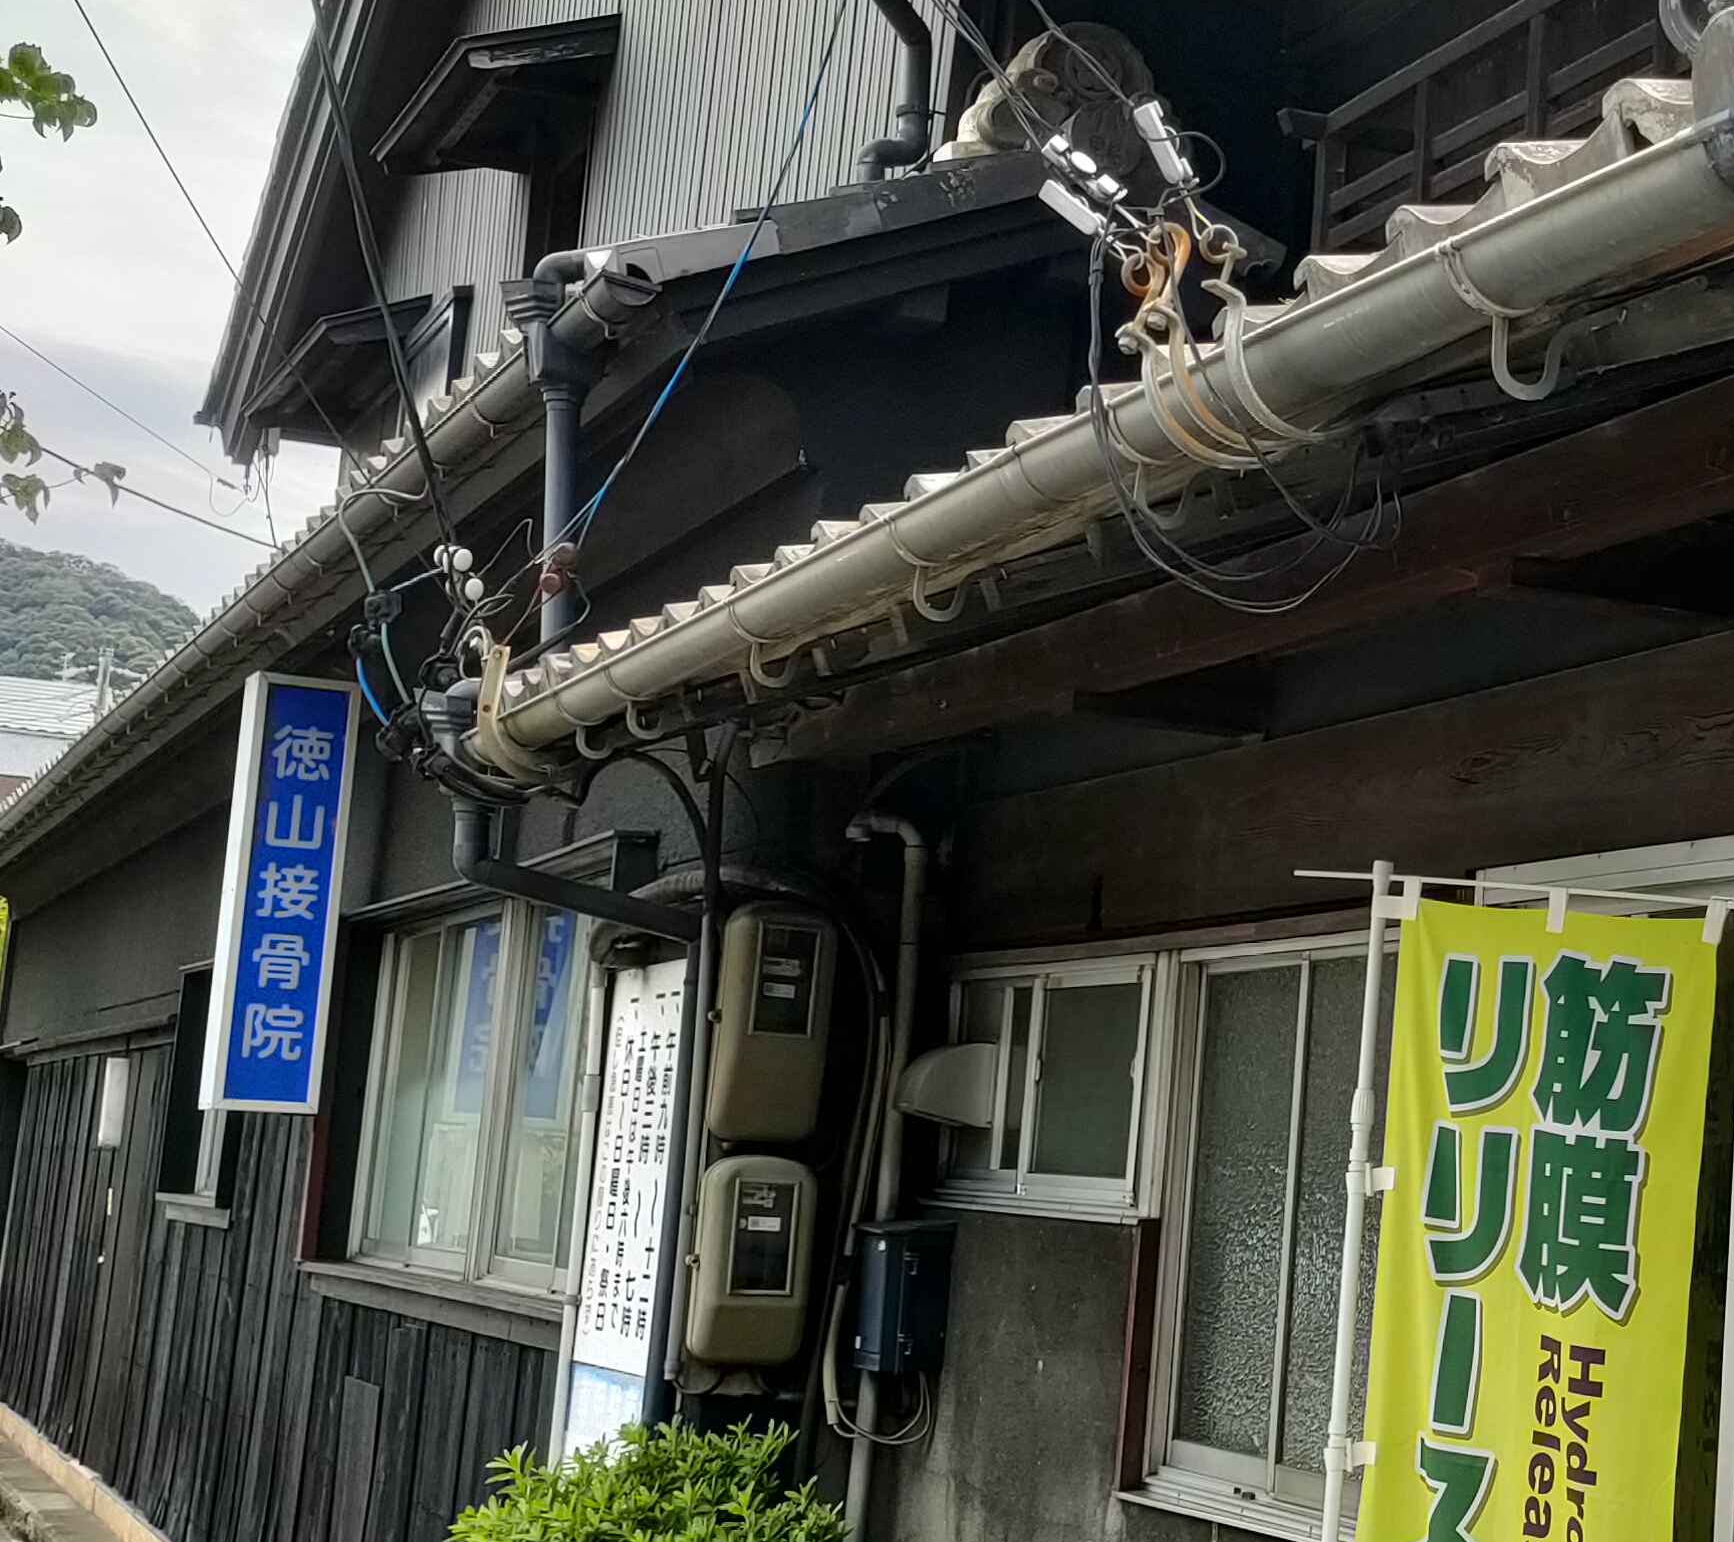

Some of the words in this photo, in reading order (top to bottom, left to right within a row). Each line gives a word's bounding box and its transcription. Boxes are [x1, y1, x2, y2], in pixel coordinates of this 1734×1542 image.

[240, 723, 331, 1062] 徳山接骨院
[1517, 950, 1670, 1322] 筋膜
